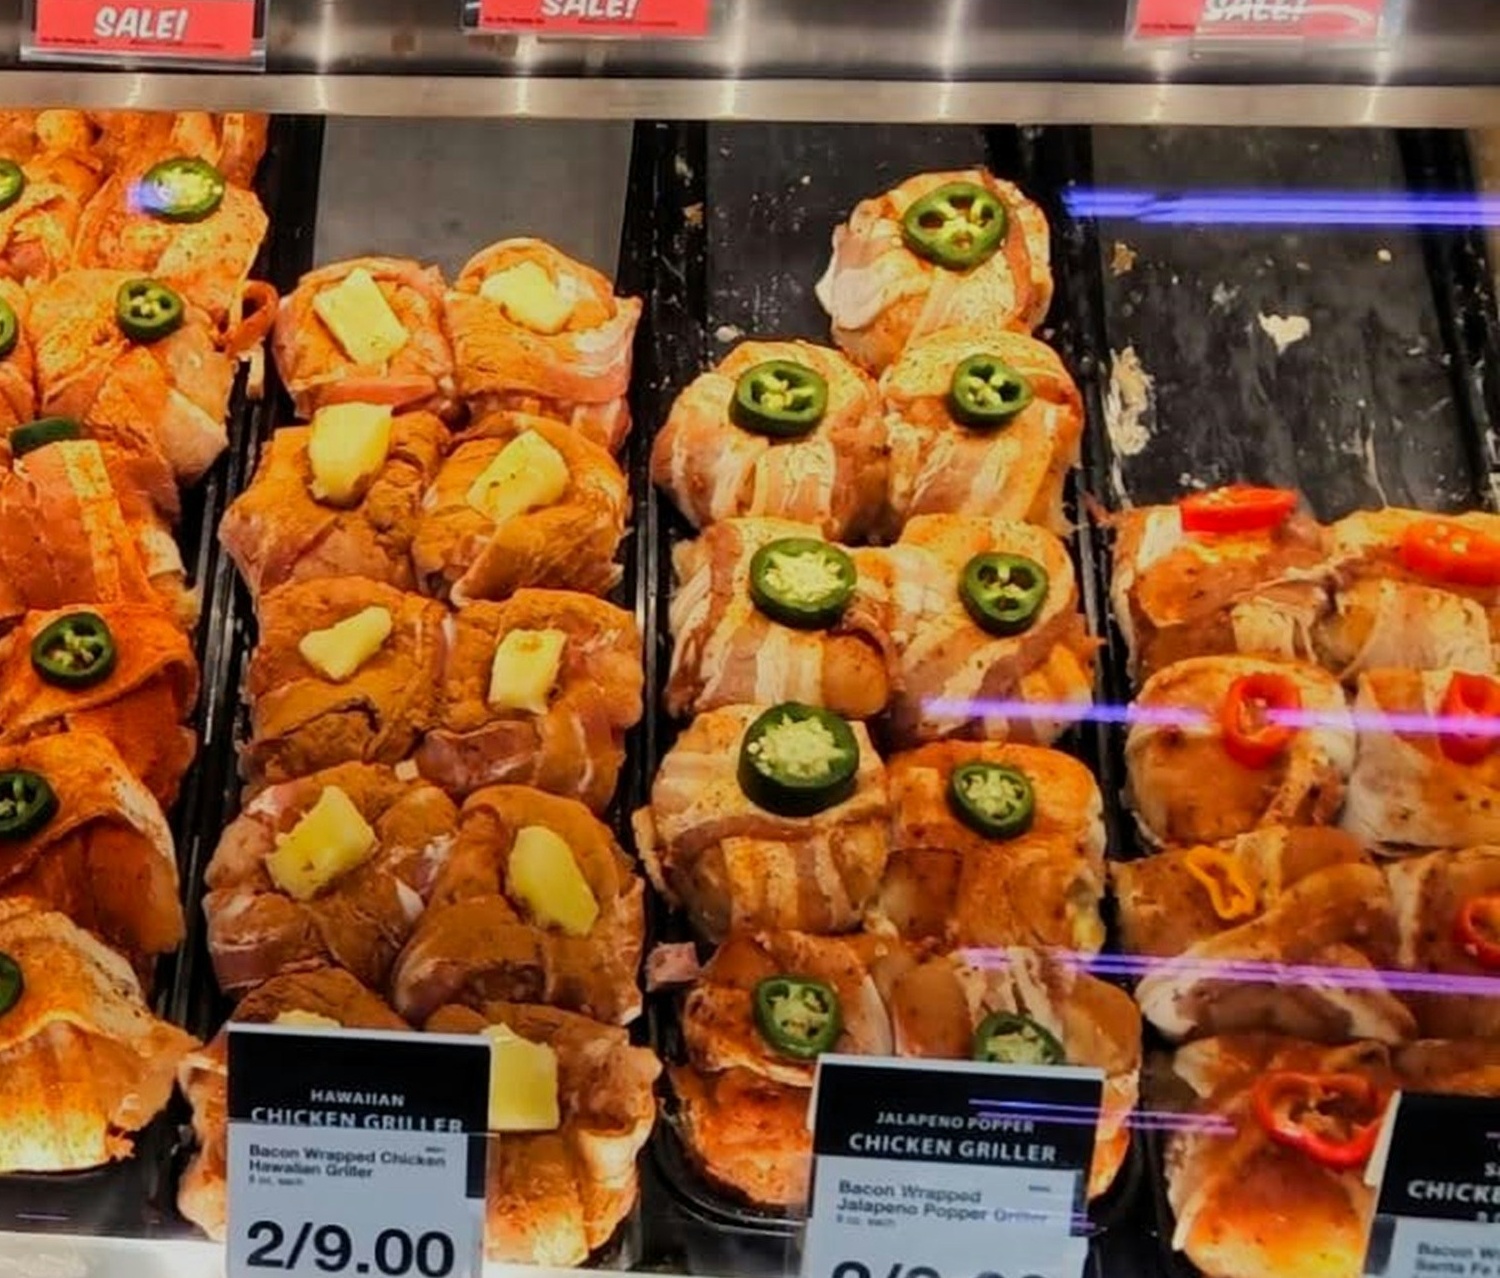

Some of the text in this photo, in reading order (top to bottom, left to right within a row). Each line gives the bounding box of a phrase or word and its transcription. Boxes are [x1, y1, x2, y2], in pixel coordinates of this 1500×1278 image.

[94, 6, 189, 40] SALE!
[311, 1089, 405, 1107] HAWAIIAN
[251, 1107, 463, 1133] CHICKEN GRILLER
[876, 1111, 1034, 1133] JALAPENO POPPER
[249, 1145, 446, 1168] Bacon Wrapped Chicken
[850, 1133, 1056, 1161] CHICKEN GRILLER
[326, 1164, 373, 1178] Griller
[838, 1179, 982, 1205] Bacon Wrapped
[837, 1198, 918, 1216] Jalapeno
[923, 1203, 986, 1222] Popper
[247, 1220, 455, 1278] 2/9.00
